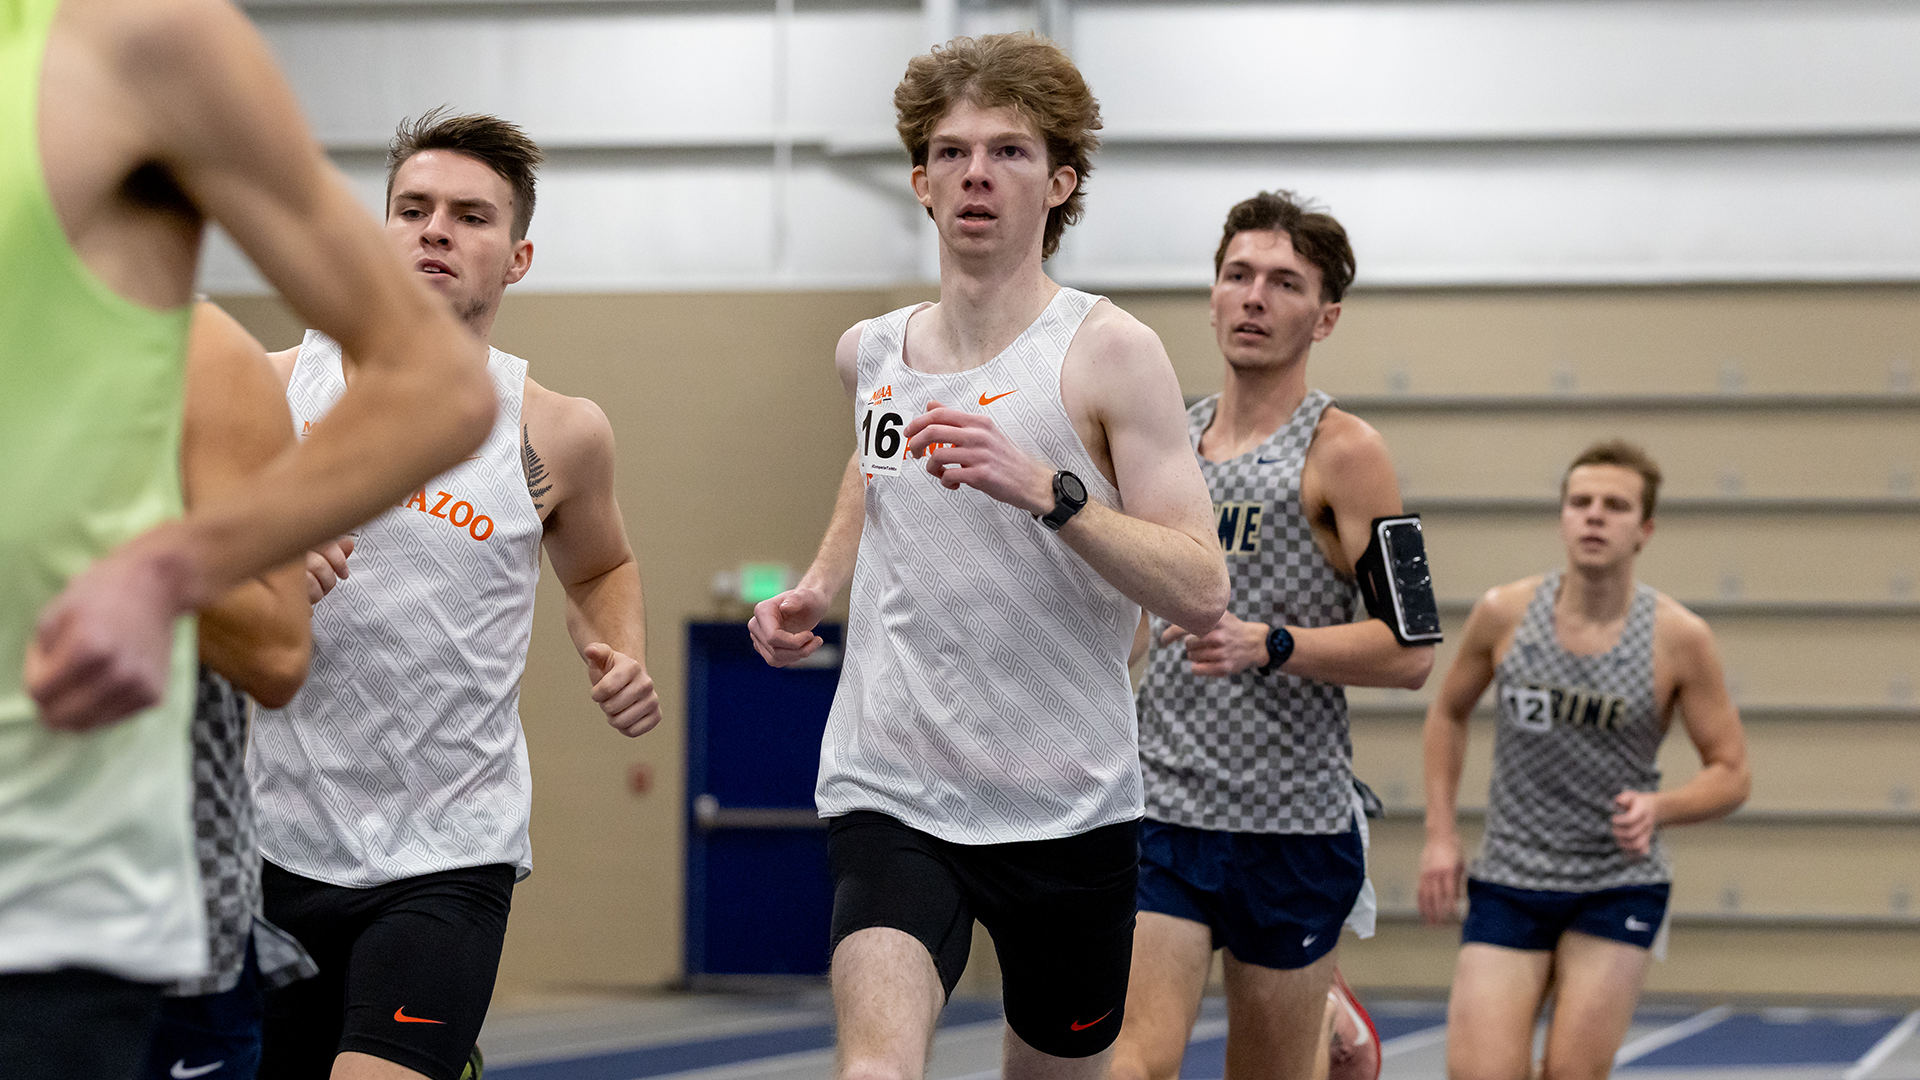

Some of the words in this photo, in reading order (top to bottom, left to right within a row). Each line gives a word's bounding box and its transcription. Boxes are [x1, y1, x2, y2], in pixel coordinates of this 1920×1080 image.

[862, 410, 904, 459] 16
[399, 484, 495, 541] AZOO
[1508, 694, 1545, 724] 12
[1527, 684, 1627, 731] RINE
